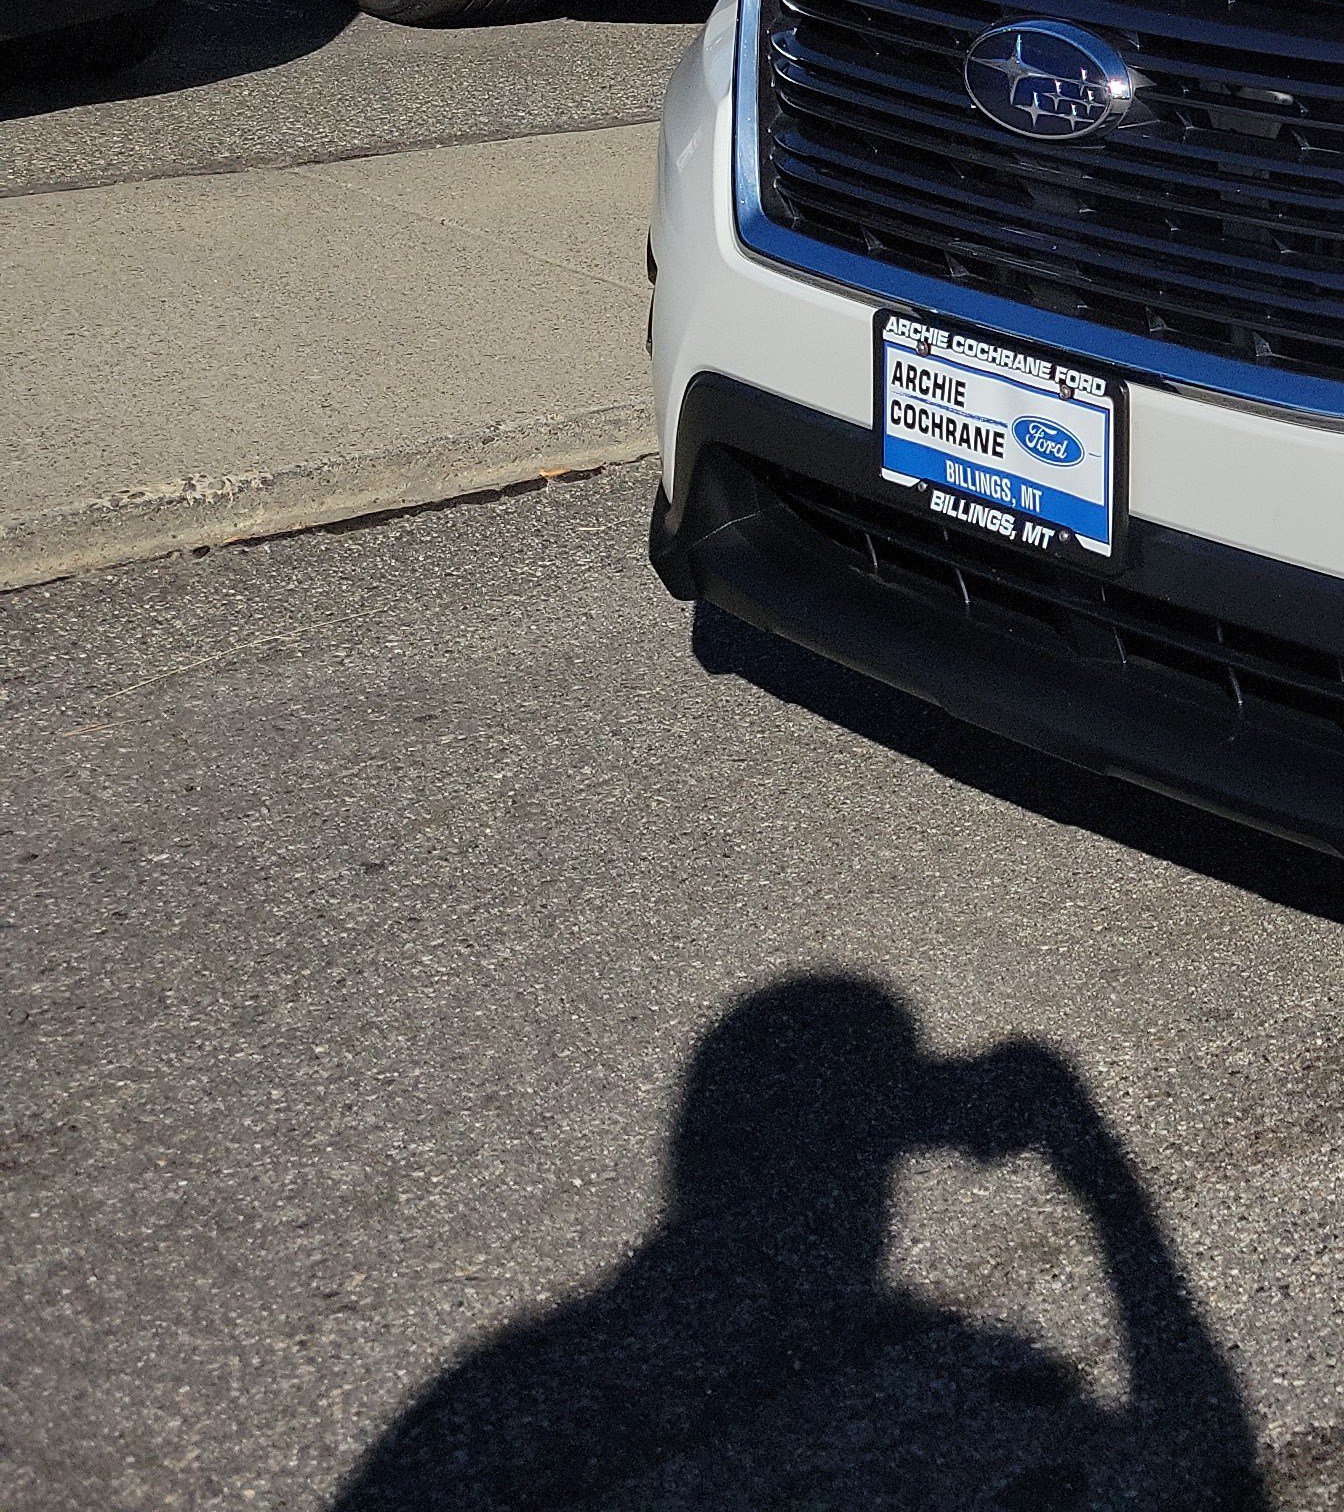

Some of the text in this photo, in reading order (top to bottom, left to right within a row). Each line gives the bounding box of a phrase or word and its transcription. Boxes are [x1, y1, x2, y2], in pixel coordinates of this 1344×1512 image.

[885, 316, 1107, 396] ARCHIE COCHRANE FORD
[891, 360, 967, 409] ARCHIE
[890, 398, 1006, 459] COCHRANE
[1025, 422, 1068, 460] Ford
[945, 459, 1043, 513] BILLINGS, MT
[930, 490, 1055, 550] BILLINGS, MT
